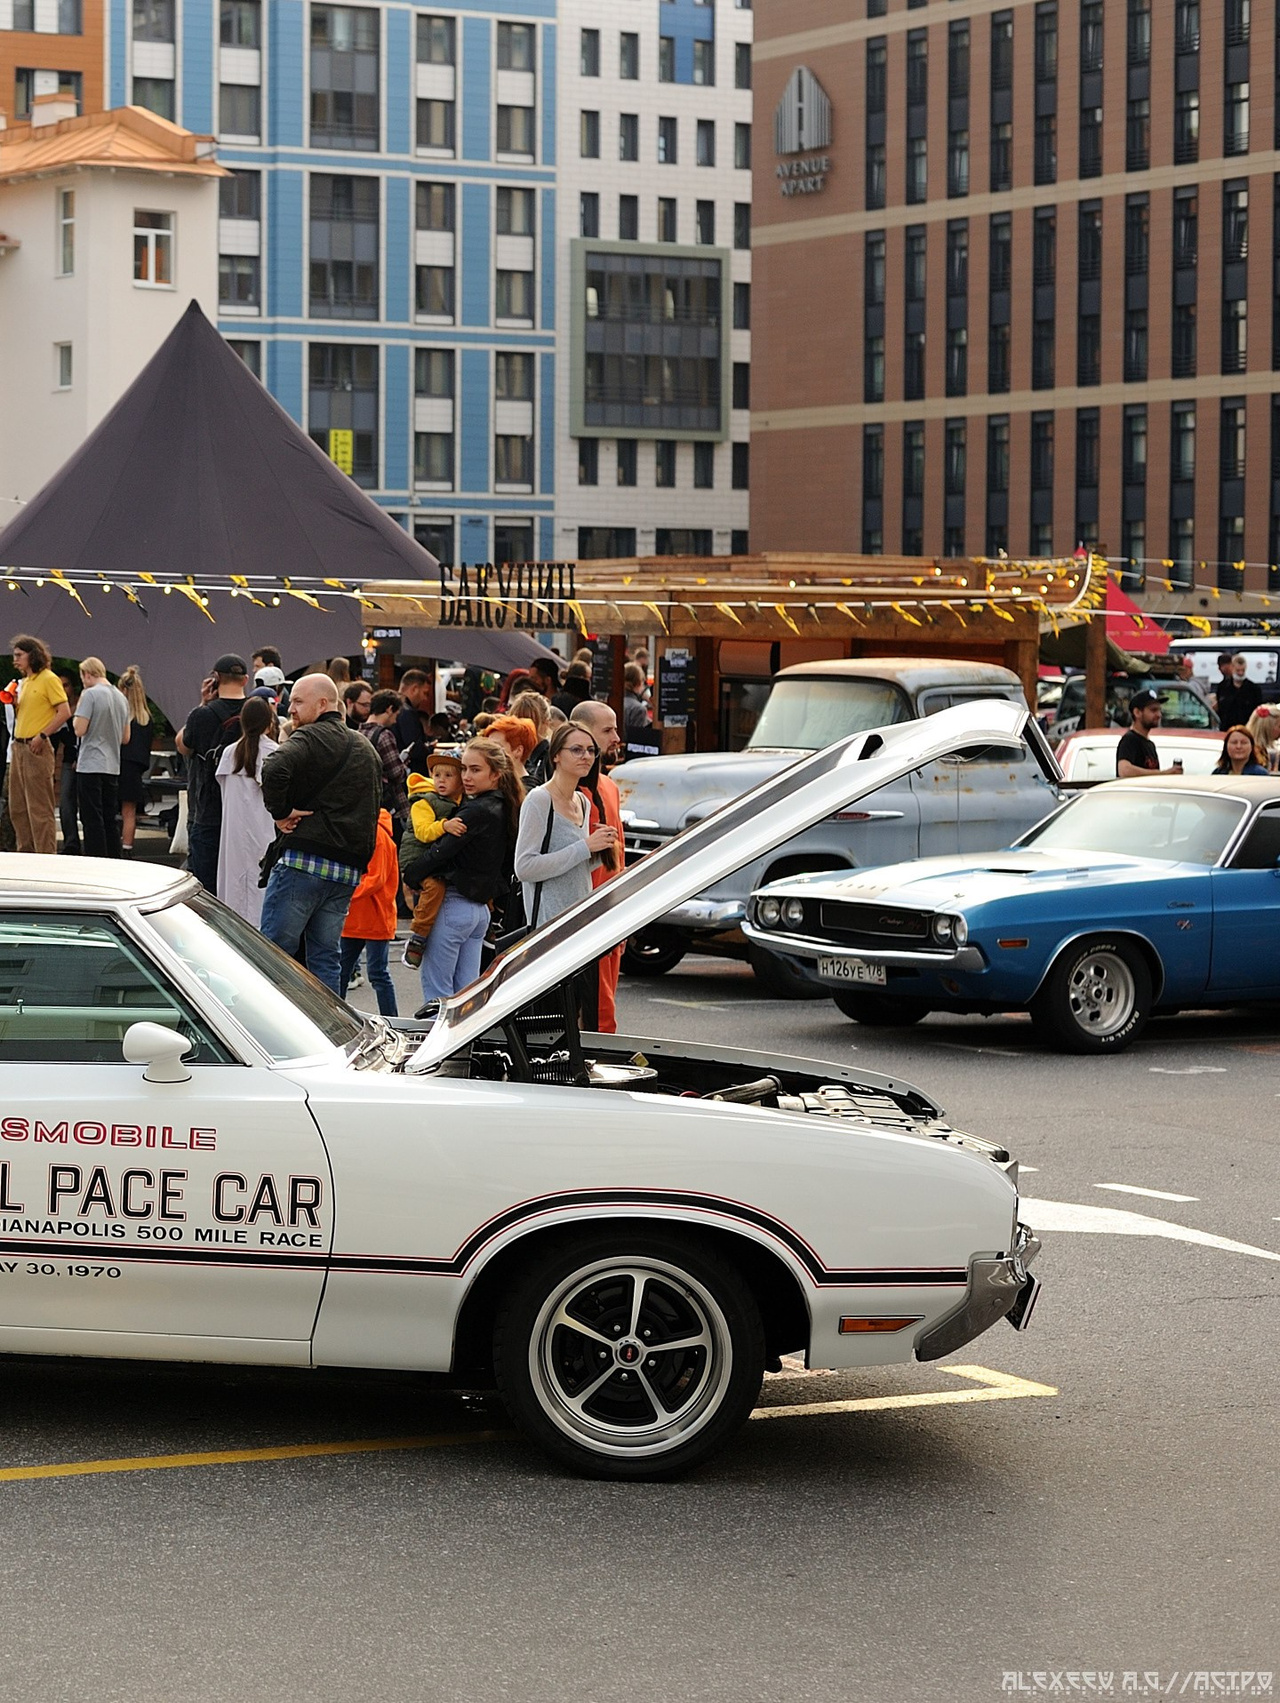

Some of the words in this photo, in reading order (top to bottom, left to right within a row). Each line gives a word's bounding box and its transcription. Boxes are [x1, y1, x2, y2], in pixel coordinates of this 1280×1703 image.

[776, 156, 830, 177] AVENUE
[781, 174, 824, 196] APART
[439, 562, 577, 628] БАКУНИН
[822, 960, 863, 979] Н126УЕ
[48, 1162, 188, 1222] PACE
[211, 1171, 323, 1229] CAR
[137, 1226, 184, 1241] 500
[194, 1228, 248, 1244] MILE
[259, 1231, 323, 1248] RACE
[26, 1262, 61, 1277] 30,
[67, 1265, 122, 1279] 1970
